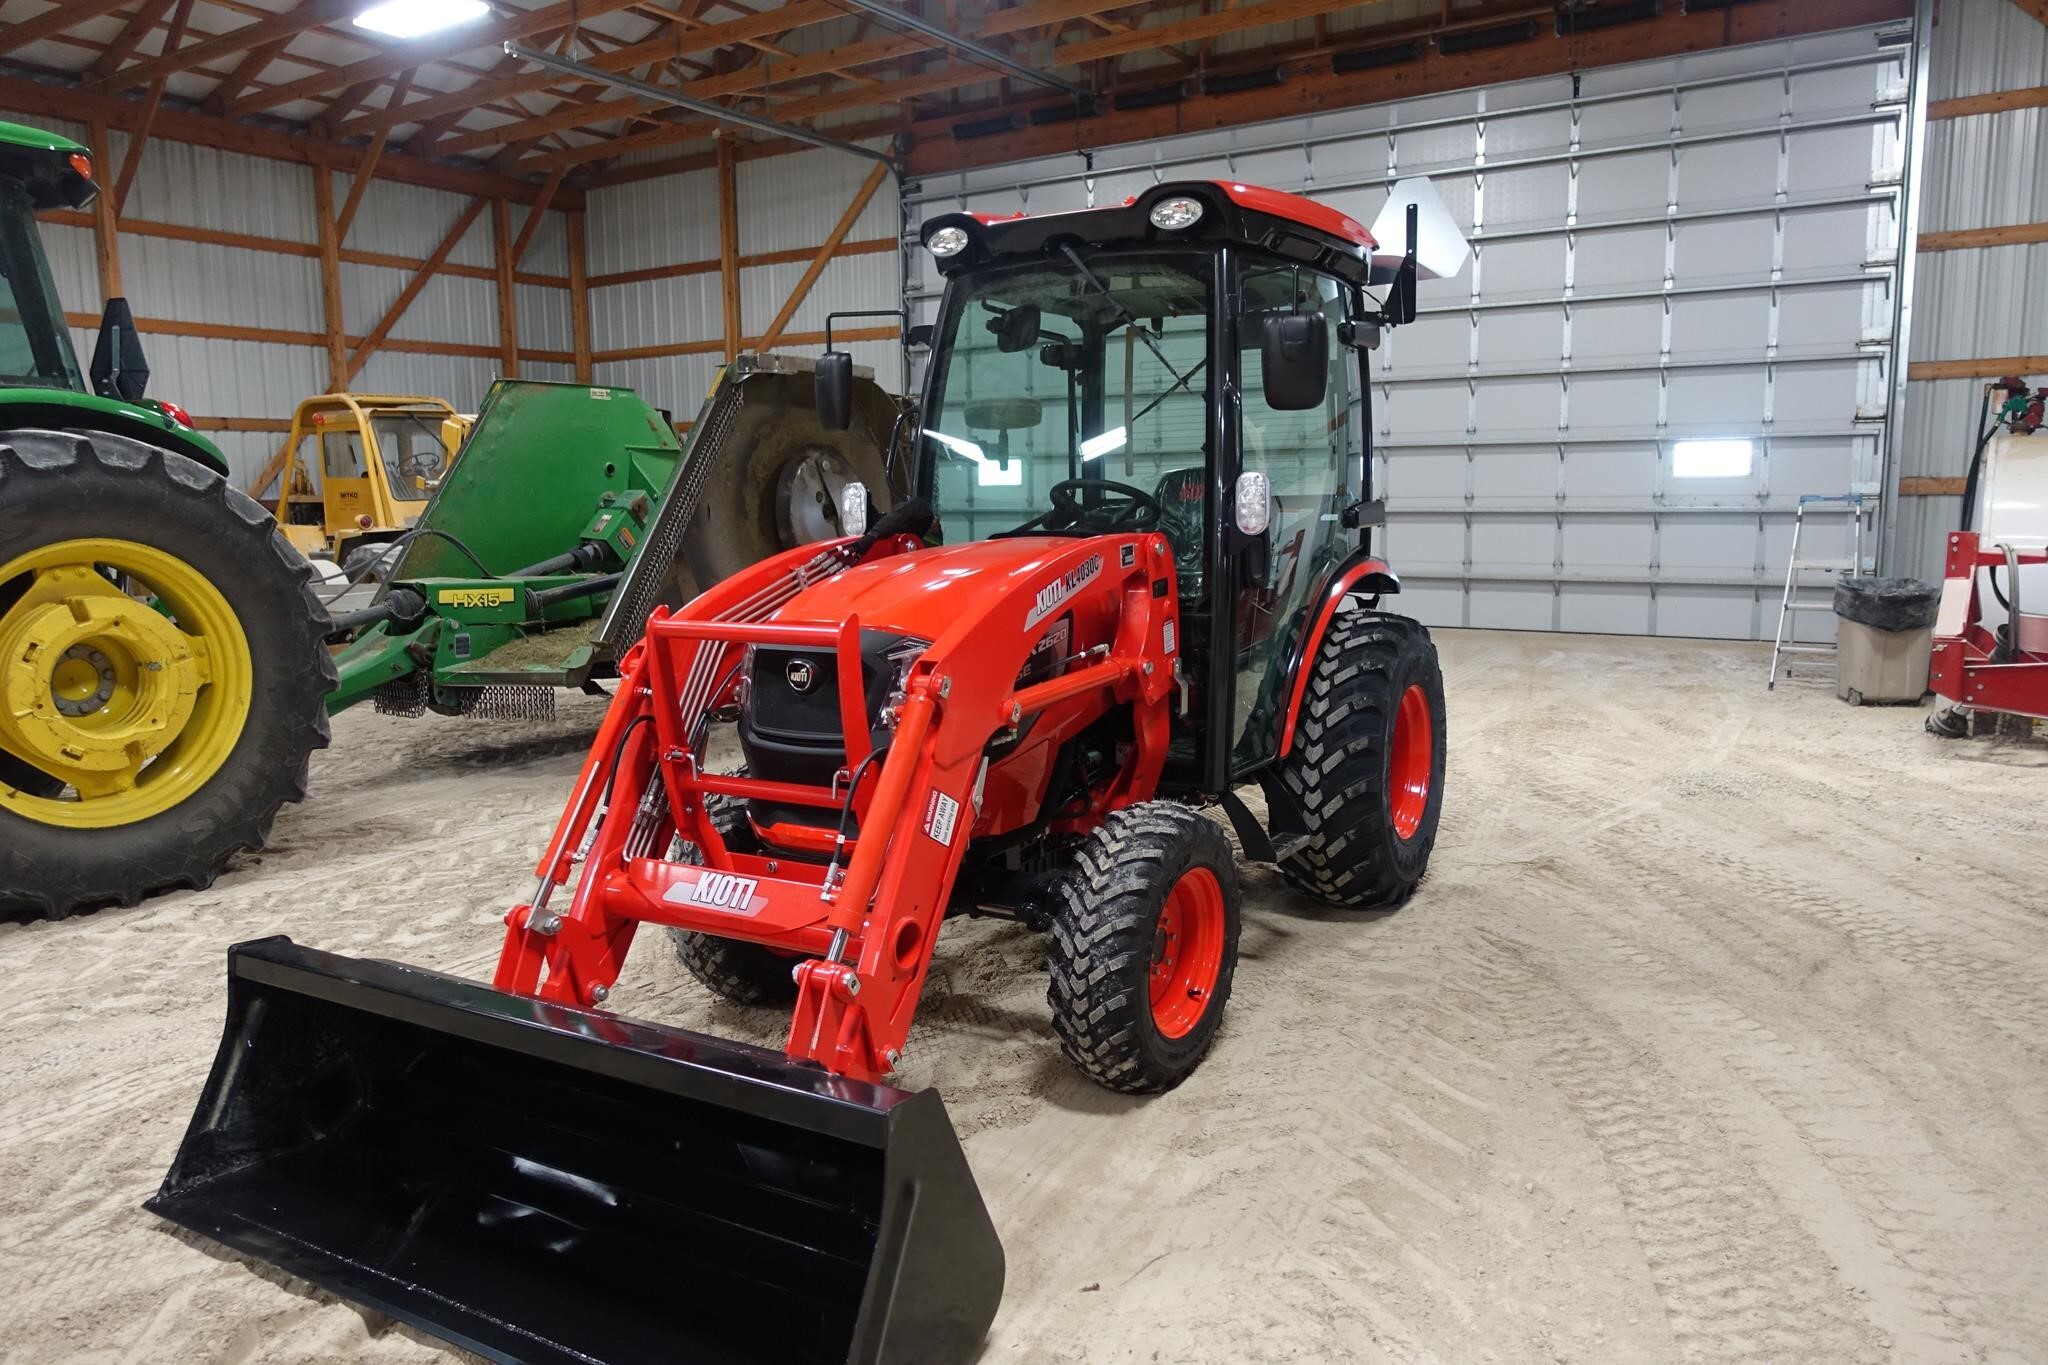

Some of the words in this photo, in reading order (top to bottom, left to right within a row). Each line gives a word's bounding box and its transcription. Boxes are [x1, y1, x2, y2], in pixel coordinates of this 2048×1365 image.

[1036, 577, 1062, 616] KIOTI
[1065, 554, 1100, 592] KL4030C
[926, 790, 938, 822] WARNING
[933, 818, 943, 839] KEEP
[938, 796, 949, 820] AWAY
[690, 870, 759, 911] KIOTI
